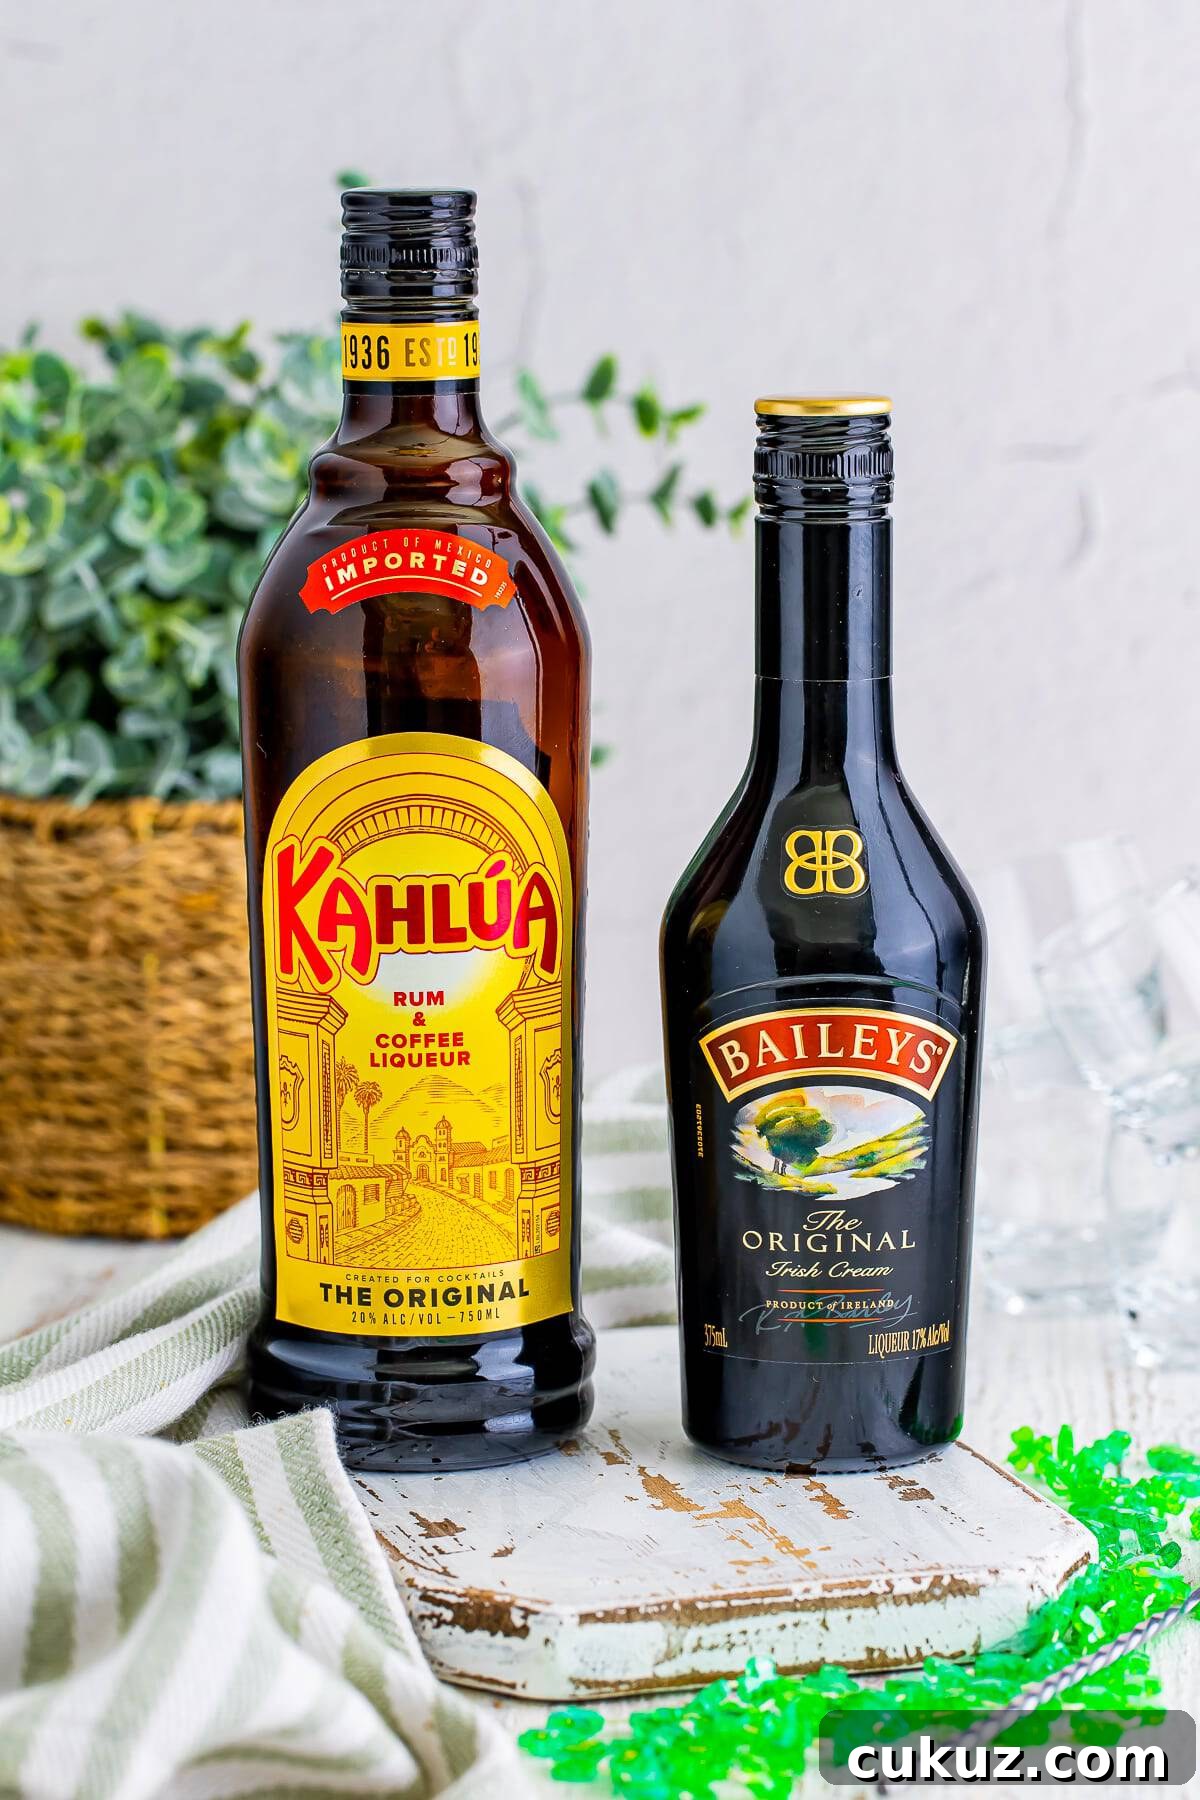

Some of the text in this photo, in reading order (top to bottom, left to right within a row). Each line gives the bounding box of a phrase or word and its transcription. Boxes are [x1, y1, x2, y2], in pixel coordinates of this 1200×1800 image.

[343, 334, 390, 370] 1936
[464, 332, 480, 367] 19
[322, 537, 492, 573] PRODUCT OF MEXICO
[324, 551, 489, 592] IMPORTED
[277, 844, 558, 985] KAHLÚA
[393, 990, 445, 1007] RUM
[412, 1012, 426, 1027] &
[375, 1031, 464, 1049] COFFEE
[369, 1050, 471, 1068] LIQUEUR
[802, 1210, 862, 1231] The
[742, 1229, 916, 1253] ORIGINAL
[345, 1269, 505, 1284] CREATED FOR COCKTAILS
[765, 1261, 894, 1278] Irish Cream
[319, 1278, 530, 1308] THE ORIGINAL
[766, 1299, 895, 1312] PRODUCT of IRELAND
[352, 1311, 376, 1325] 20%
[383, 1311, 441, 1326] ALC/VOL
[704, 1323, 728, 1348] 375mL
[868, 1320, 950, 1359] LIQUEUR 17% Alc/Vol
